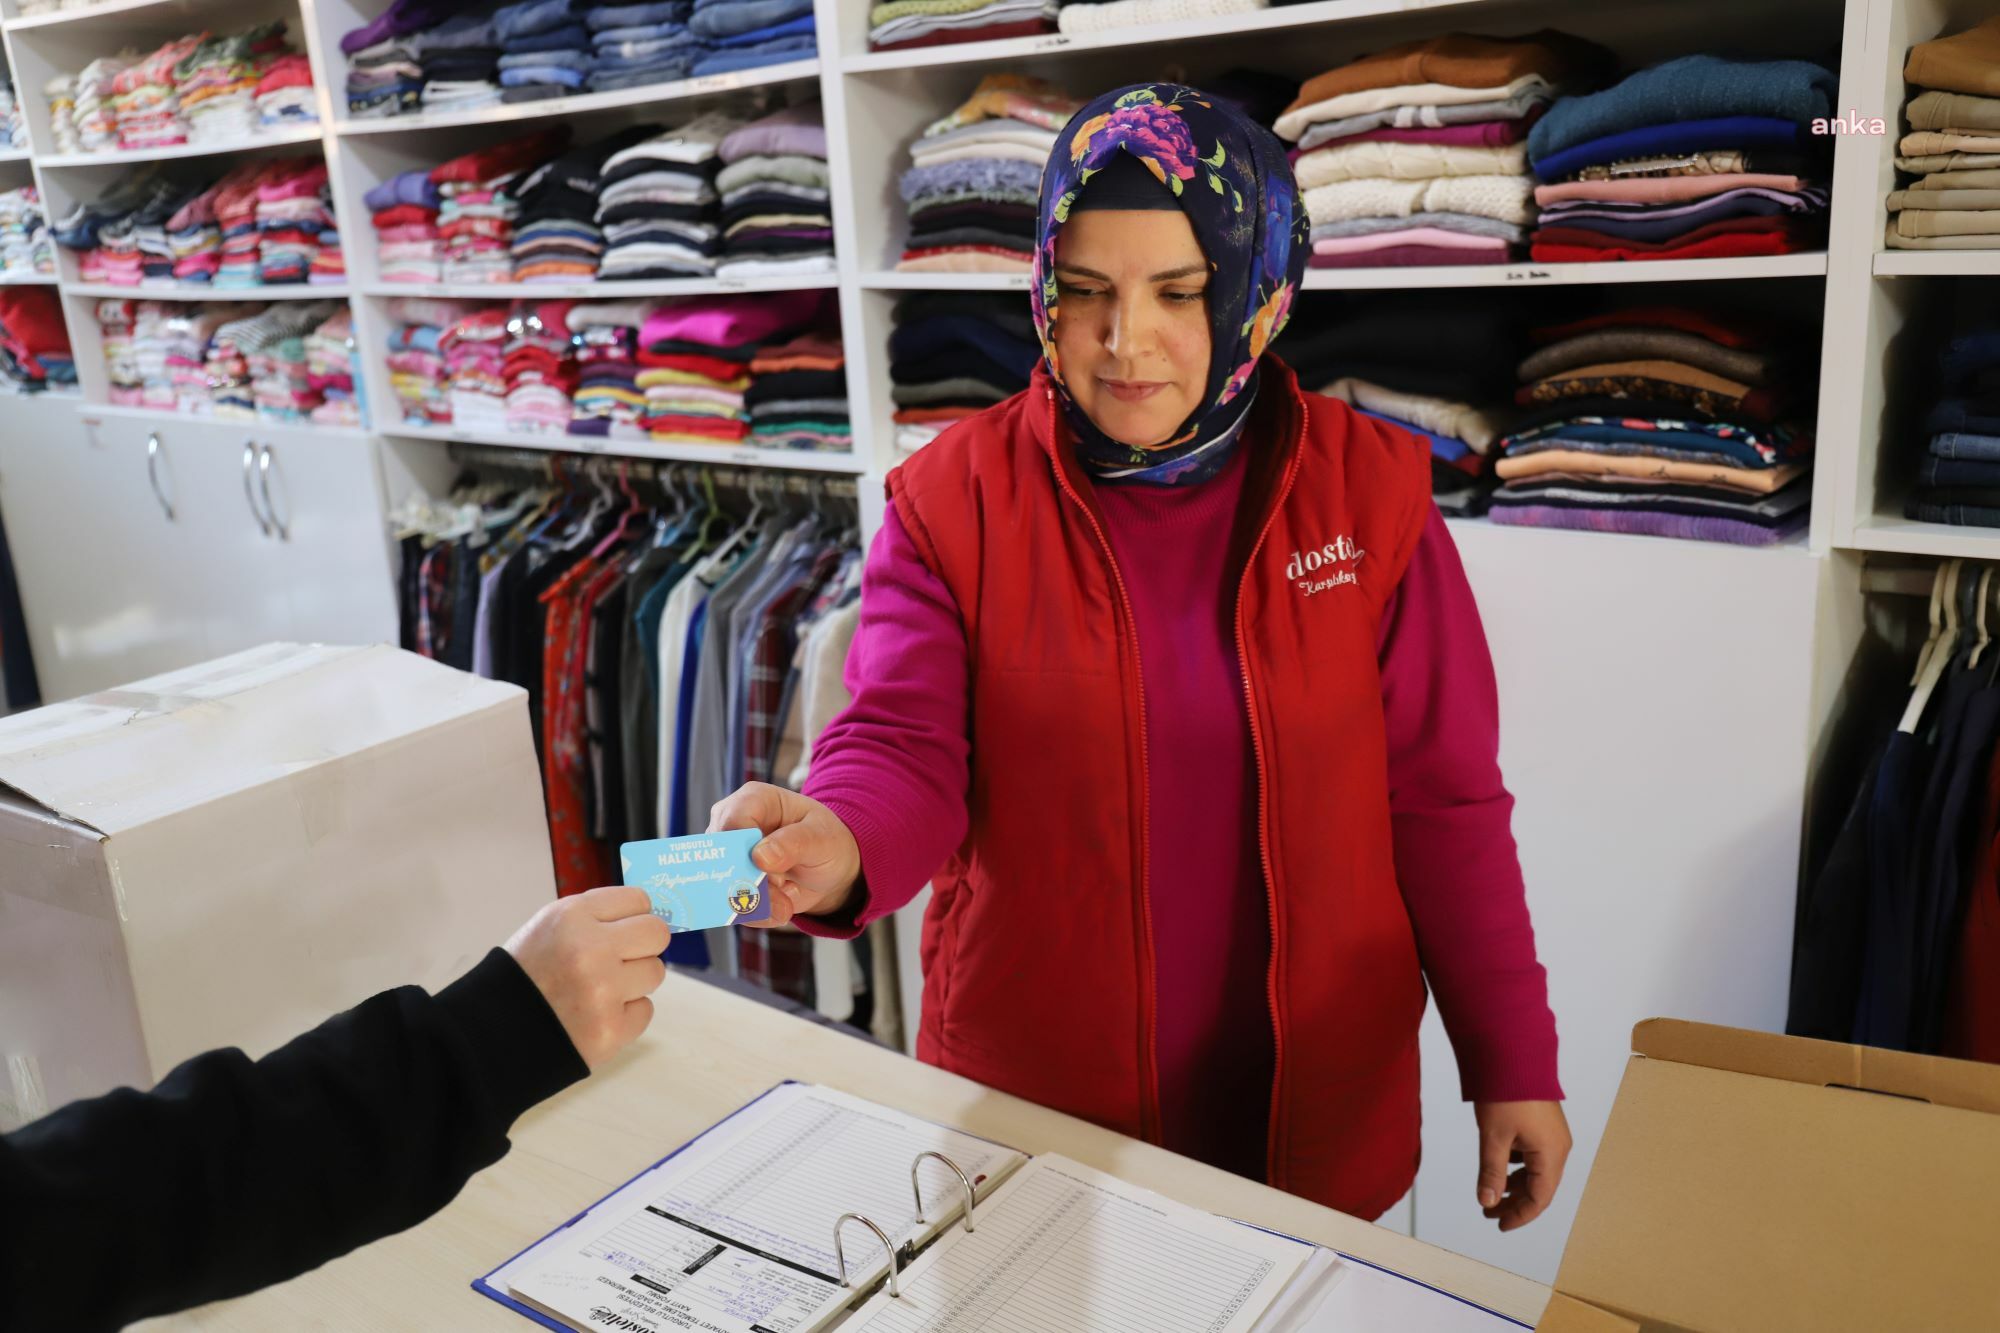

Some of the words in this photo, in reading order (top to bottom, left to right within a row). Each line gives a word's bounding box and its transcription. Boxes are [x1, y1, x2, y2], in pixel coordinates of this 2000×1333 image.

[670, 839, 714, 851] TURGUTLU
[658, 852, 692, 866] HALK
[694, 847, 726, 861] KART
[616, 1293, 657, 1314] BELEDİYESİ
[624, 1289, 655, 1306] DAĞITIM
[646, 1290, 672, 1304] FORMU
[660, 1304, 700, 1325] TEMİZLEME
[669, 1301, 692, 1313] KAYIT
[655, 1310, 693, 1330] TURGUTLU
